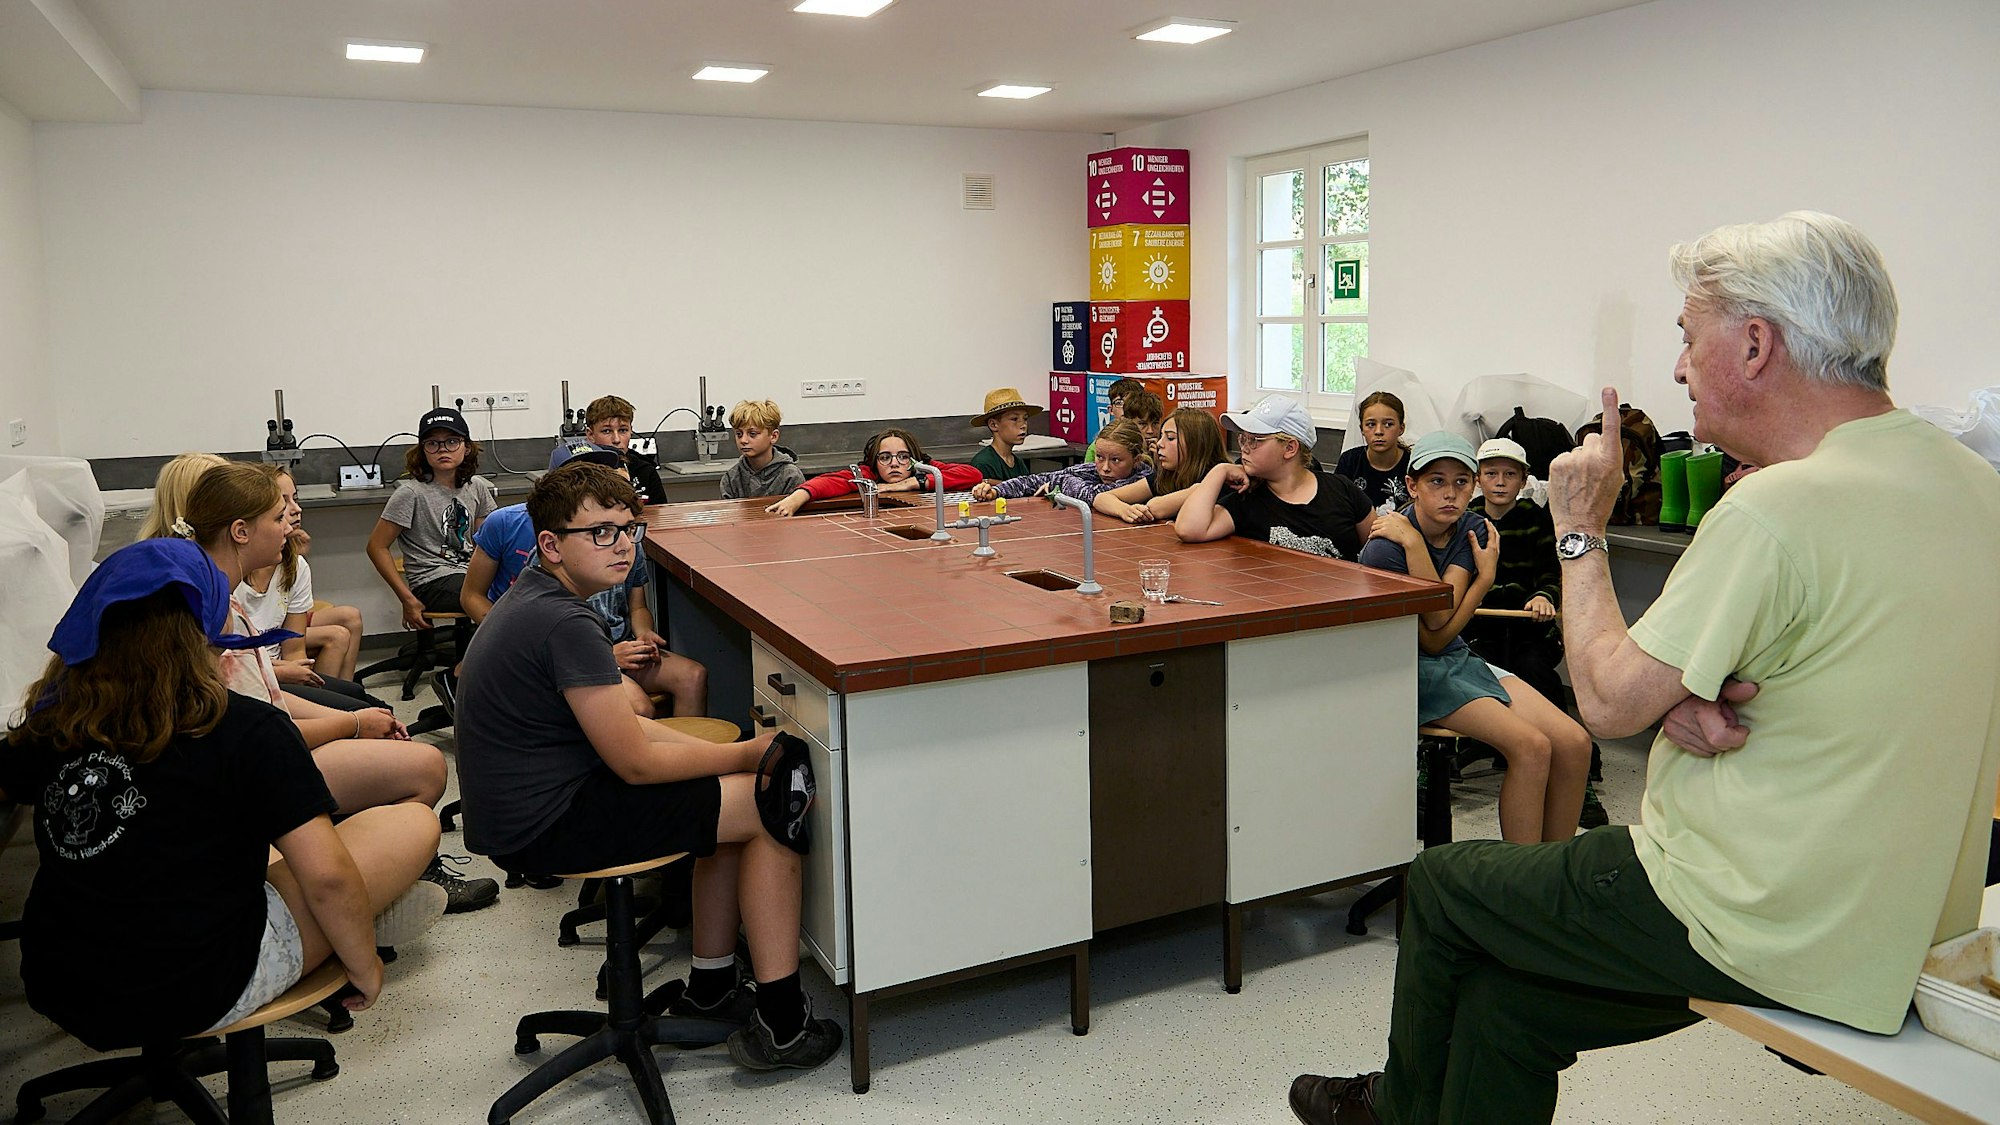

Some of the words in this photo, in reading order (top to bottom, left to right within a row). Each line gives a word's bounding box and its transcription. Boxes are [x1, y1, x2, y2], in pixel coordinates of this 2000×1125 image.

[1131, 154, 1144, 172] 10
[1147, 155, 1168, 163] WENIGER
[1089, 160, 1097, 177] 10
[1147, 164, 1184, 173] UNGLEICHHEITEN
[1092, 233, 1097, 250] 7
[1132, 230, 1140, 247] 7
[1054, 307, 1060, 322] 17
[1092, 306, 1097, 323] 5
[1176, 351, 1185, 368] 5
[1050, 376, 1059, 392] 10
[1089, 378, 1095, 394] 6
[1166, 383, 1175, 401] 9
[1177, 391, 1206, 400] INNOVATION
[1205, 391, 1216, 399] UND
